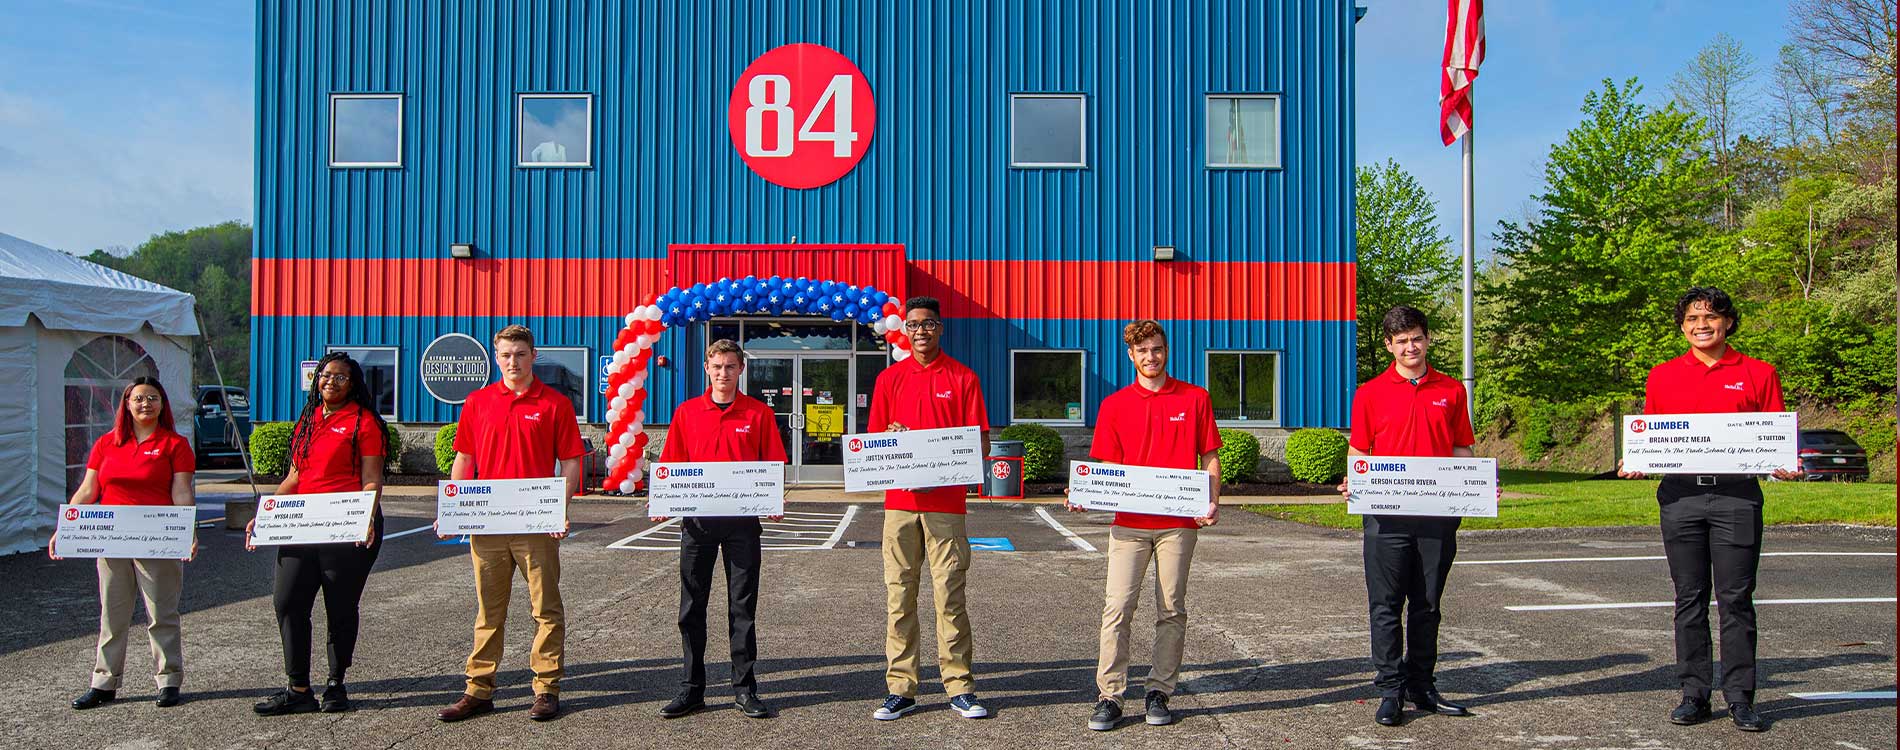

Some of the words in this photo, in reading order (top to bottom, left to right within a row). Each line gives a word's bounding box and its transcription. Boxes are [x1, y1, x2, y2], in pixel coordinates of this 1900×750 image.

[746, 74, 858, 158] 84
[425, 363, 453, 374] DESIGN
[456, 363, 485, 374] STUDIO
[1649, 421, 1689, 430] LUMBER
[864, 439, 898, 449] LUMBER
[1370, 463, 1406, 472] LUMBER
[1091, 468, 1126, 477] LUMBER
[460, 486, 491, 494] LUMBER
[276, 500, 306, 508] LUMBER
[80, 511, 114, 519] LUMBER
